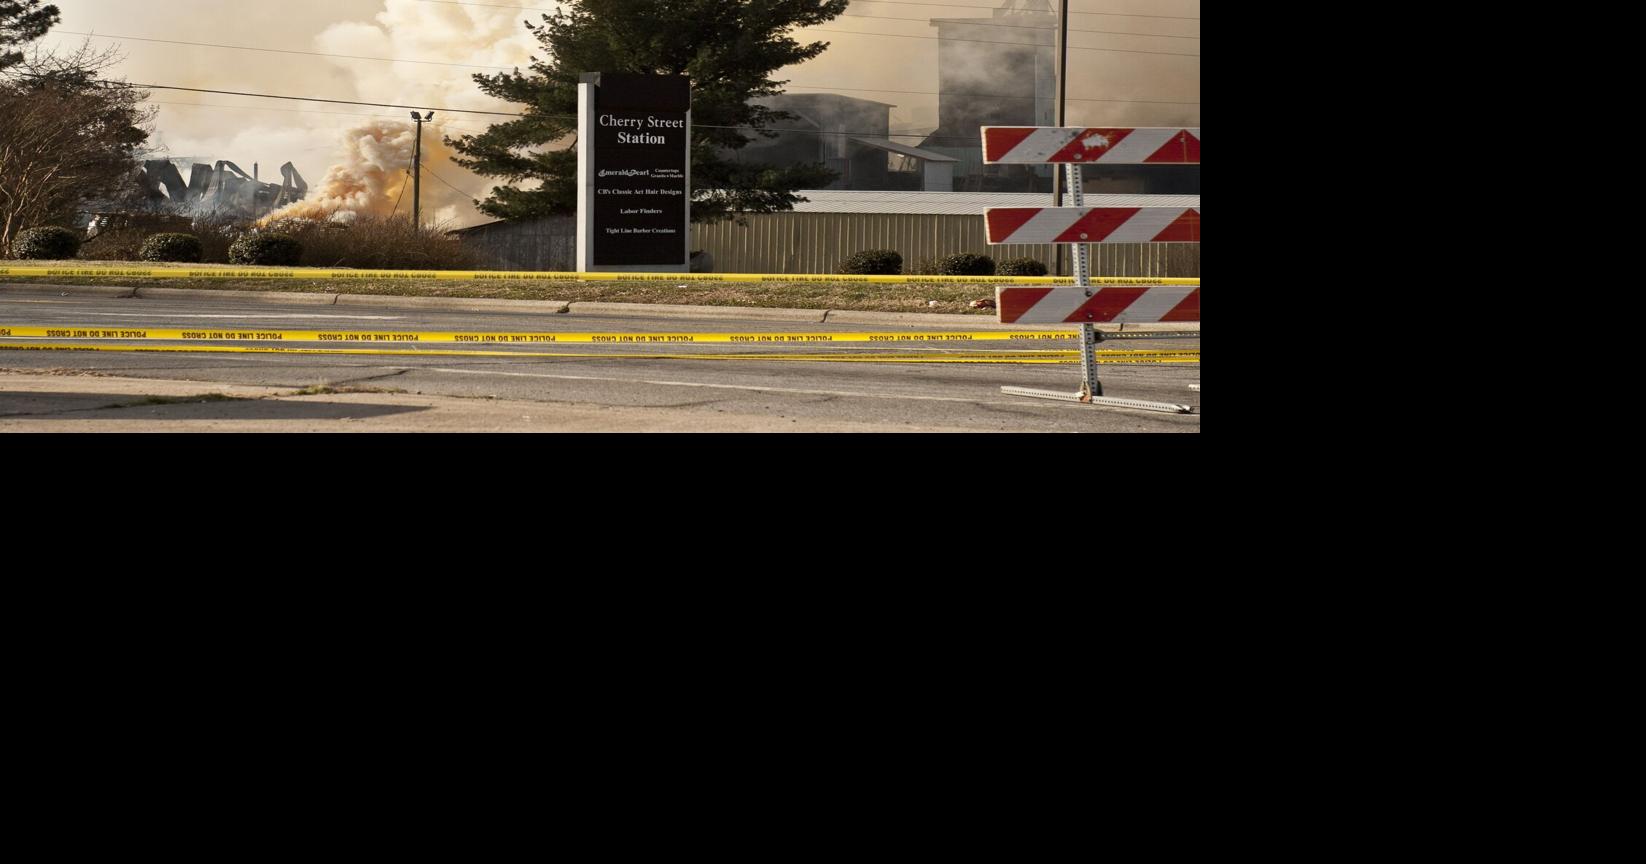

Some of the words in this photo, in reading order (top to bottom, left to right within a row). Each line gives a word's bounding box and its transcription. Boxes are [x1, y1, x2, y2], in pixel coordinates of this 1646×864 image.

[600, 114, 643, 130] Cherry
[648, 115, 684, 128] Street
[617, 131, 665, 145] Station
[660, 188, 682, 196] Designs
[47, 329, 70, 338] CROSS
[74, 330, 87, 338] NOT
[89, 330, 99, 338] DO
[102, 330, 118, 338] LINE
[121, 331, 146, 339] POLICE
